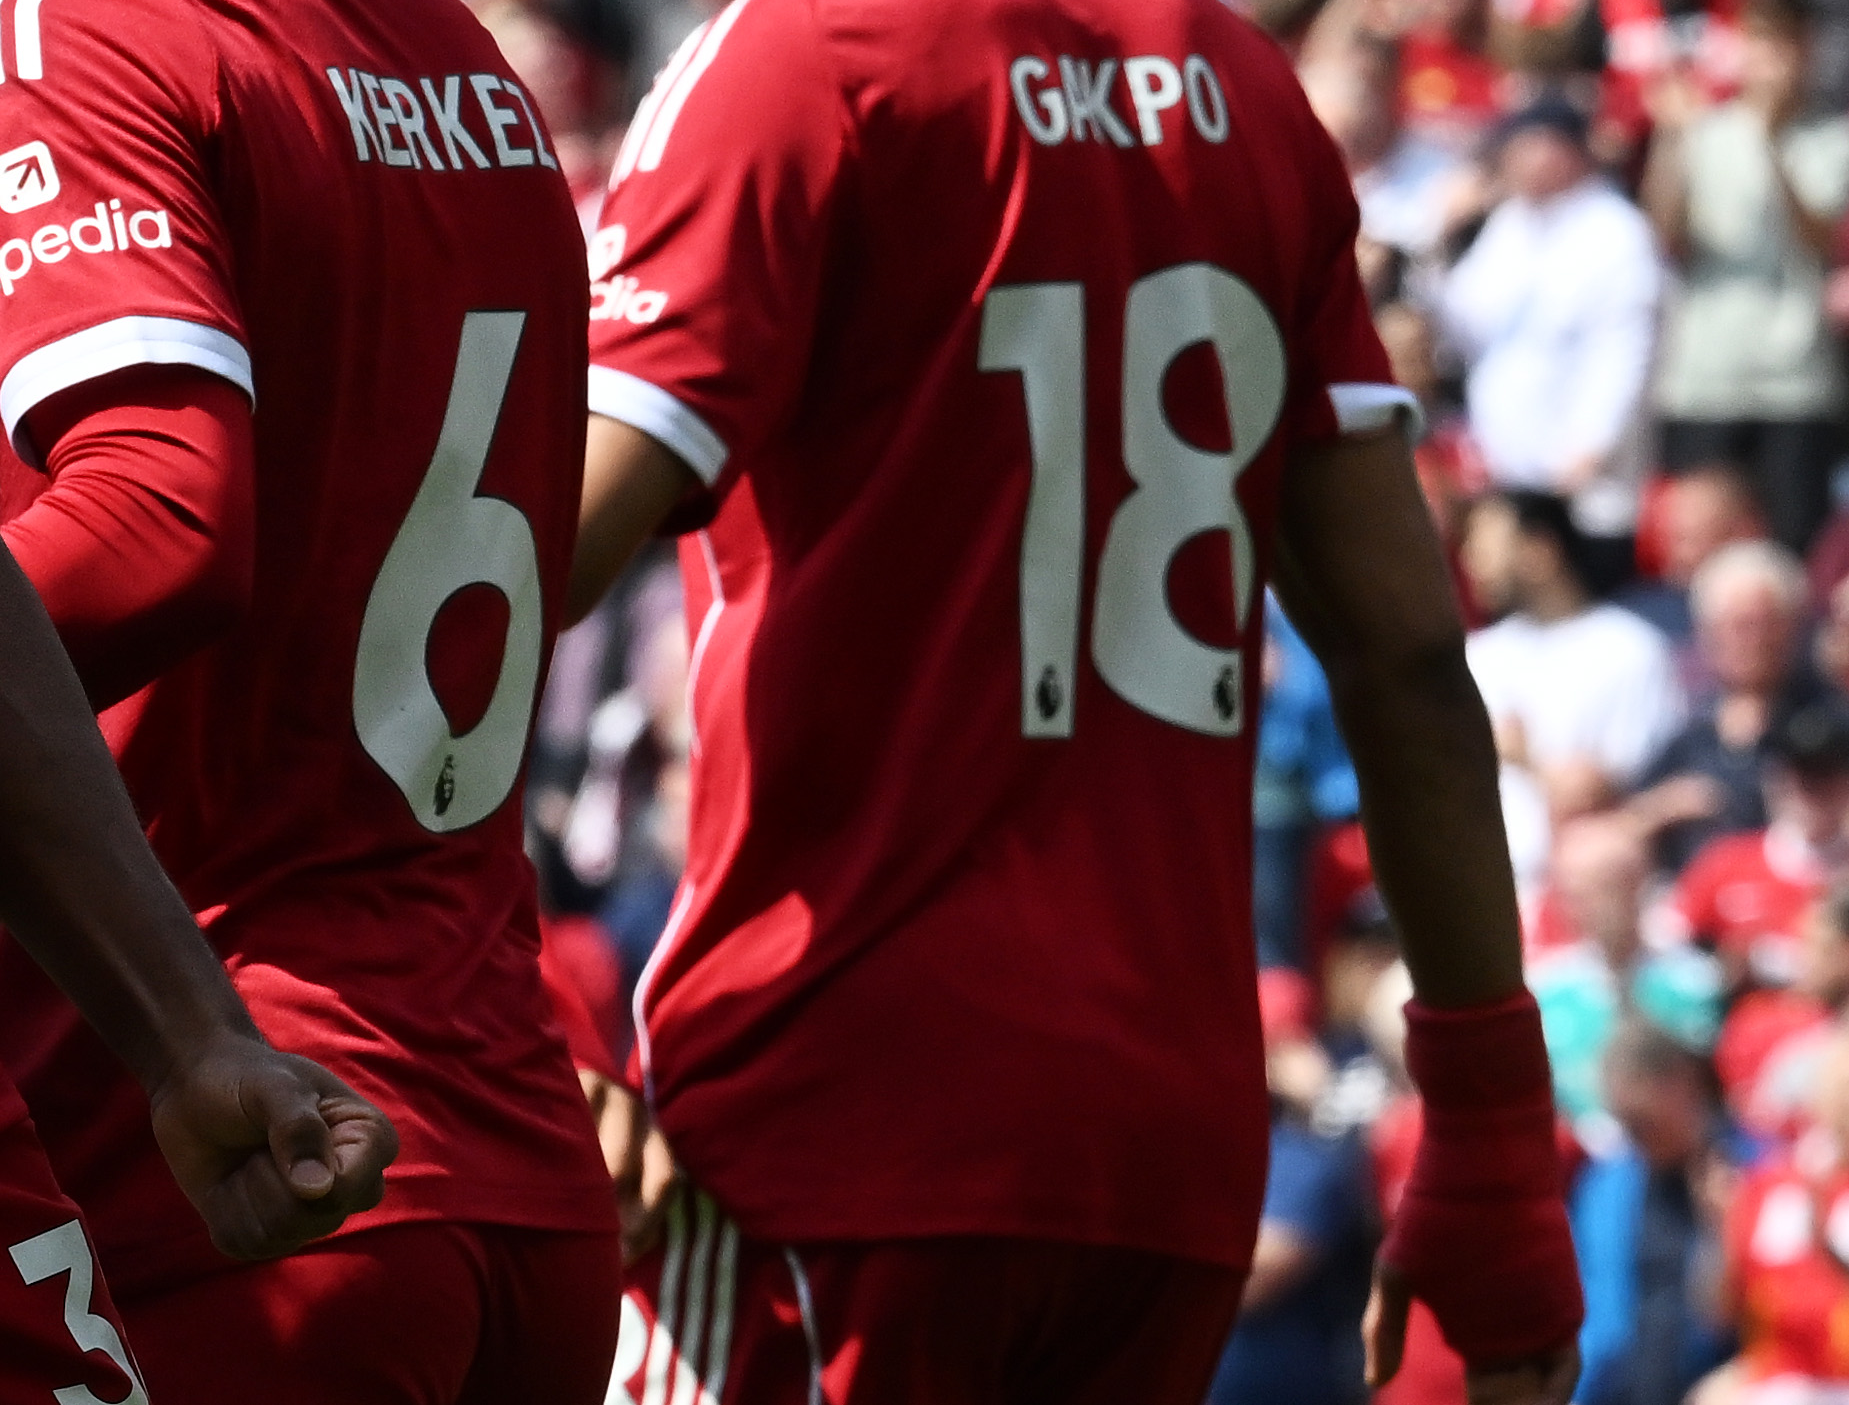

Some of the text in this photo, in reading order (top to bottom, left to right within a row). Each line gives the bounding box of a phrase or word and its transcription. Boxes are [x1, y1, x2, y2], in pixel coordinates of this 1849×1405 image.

[1010, 54, 1229, 147] GAKPO
[353, 310, 543, 833] 6
[979, 262, 1286, 737] 18
